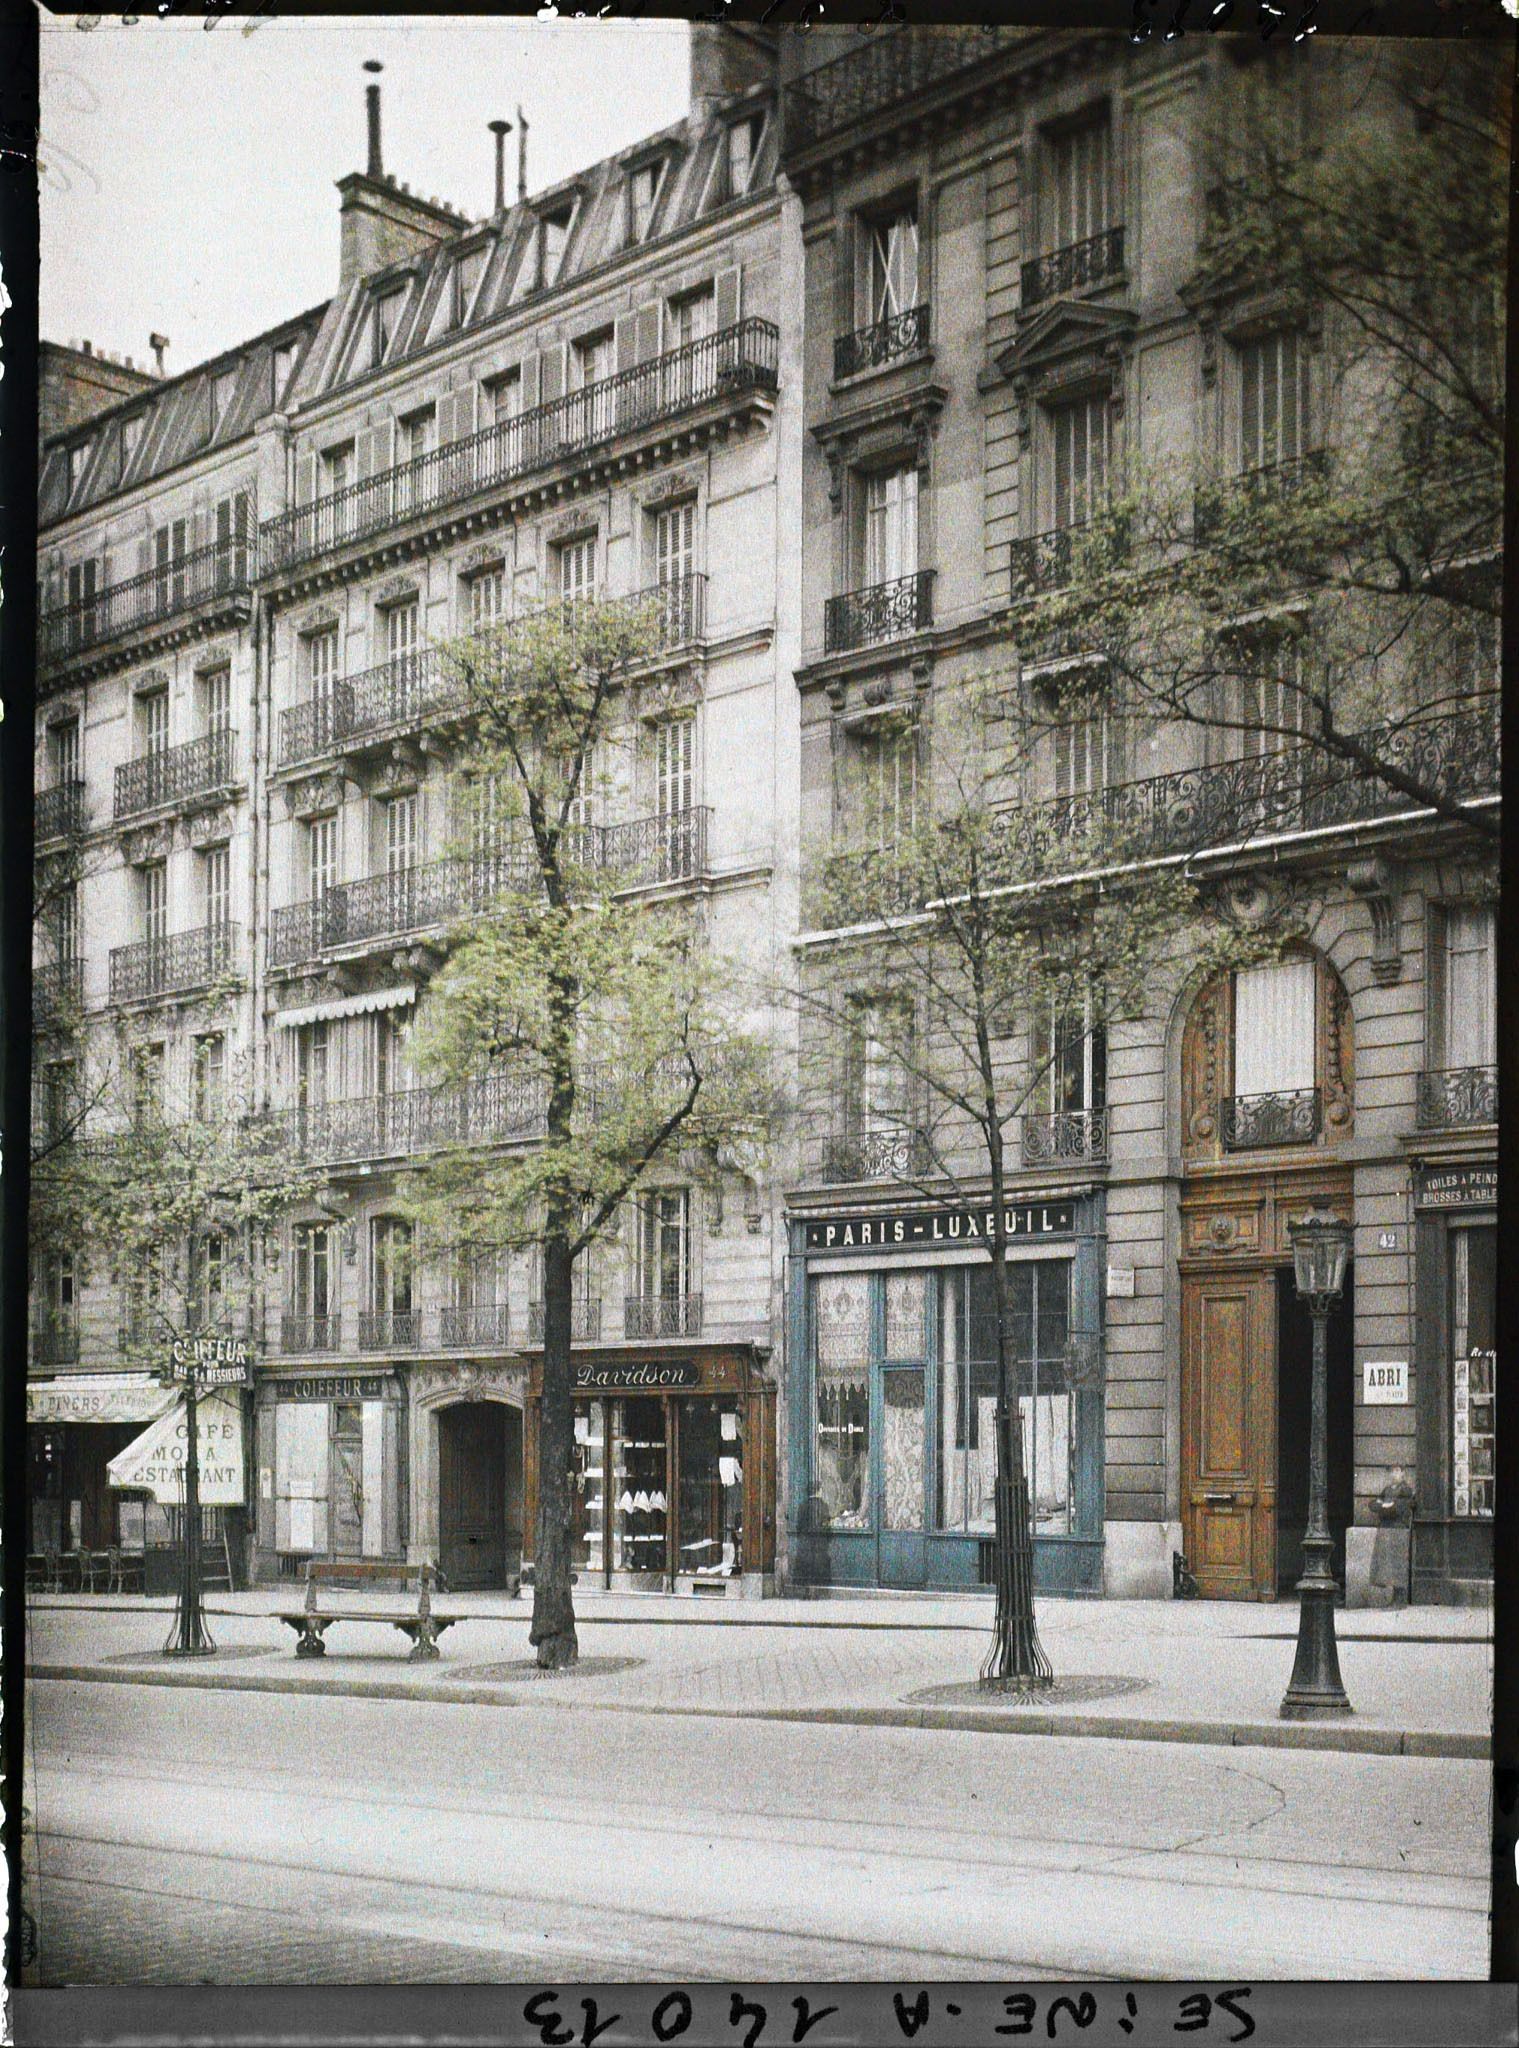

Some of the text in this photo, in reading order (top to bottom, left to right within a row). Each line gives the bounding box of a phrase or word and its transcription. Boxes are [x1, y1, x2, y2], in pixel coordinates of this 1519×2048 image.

[1426, 1174, 1458, 1190] TOILES
[1422, 1190, 1462, 1205] BROSSES
[1379, 1233, 1396, 1249] 42
[206, 1366, 247, 1383] MESSIEURS
[576, 1363, 727, 1387] Davidson 44
[1368, 1367, 1402, 1387] ABRI
[294, 1379, 362, 1398] COIFFEUR
[151, 1446, 219, 1462] MOA
[131, 1468, 236, 1483] ESTAANT
